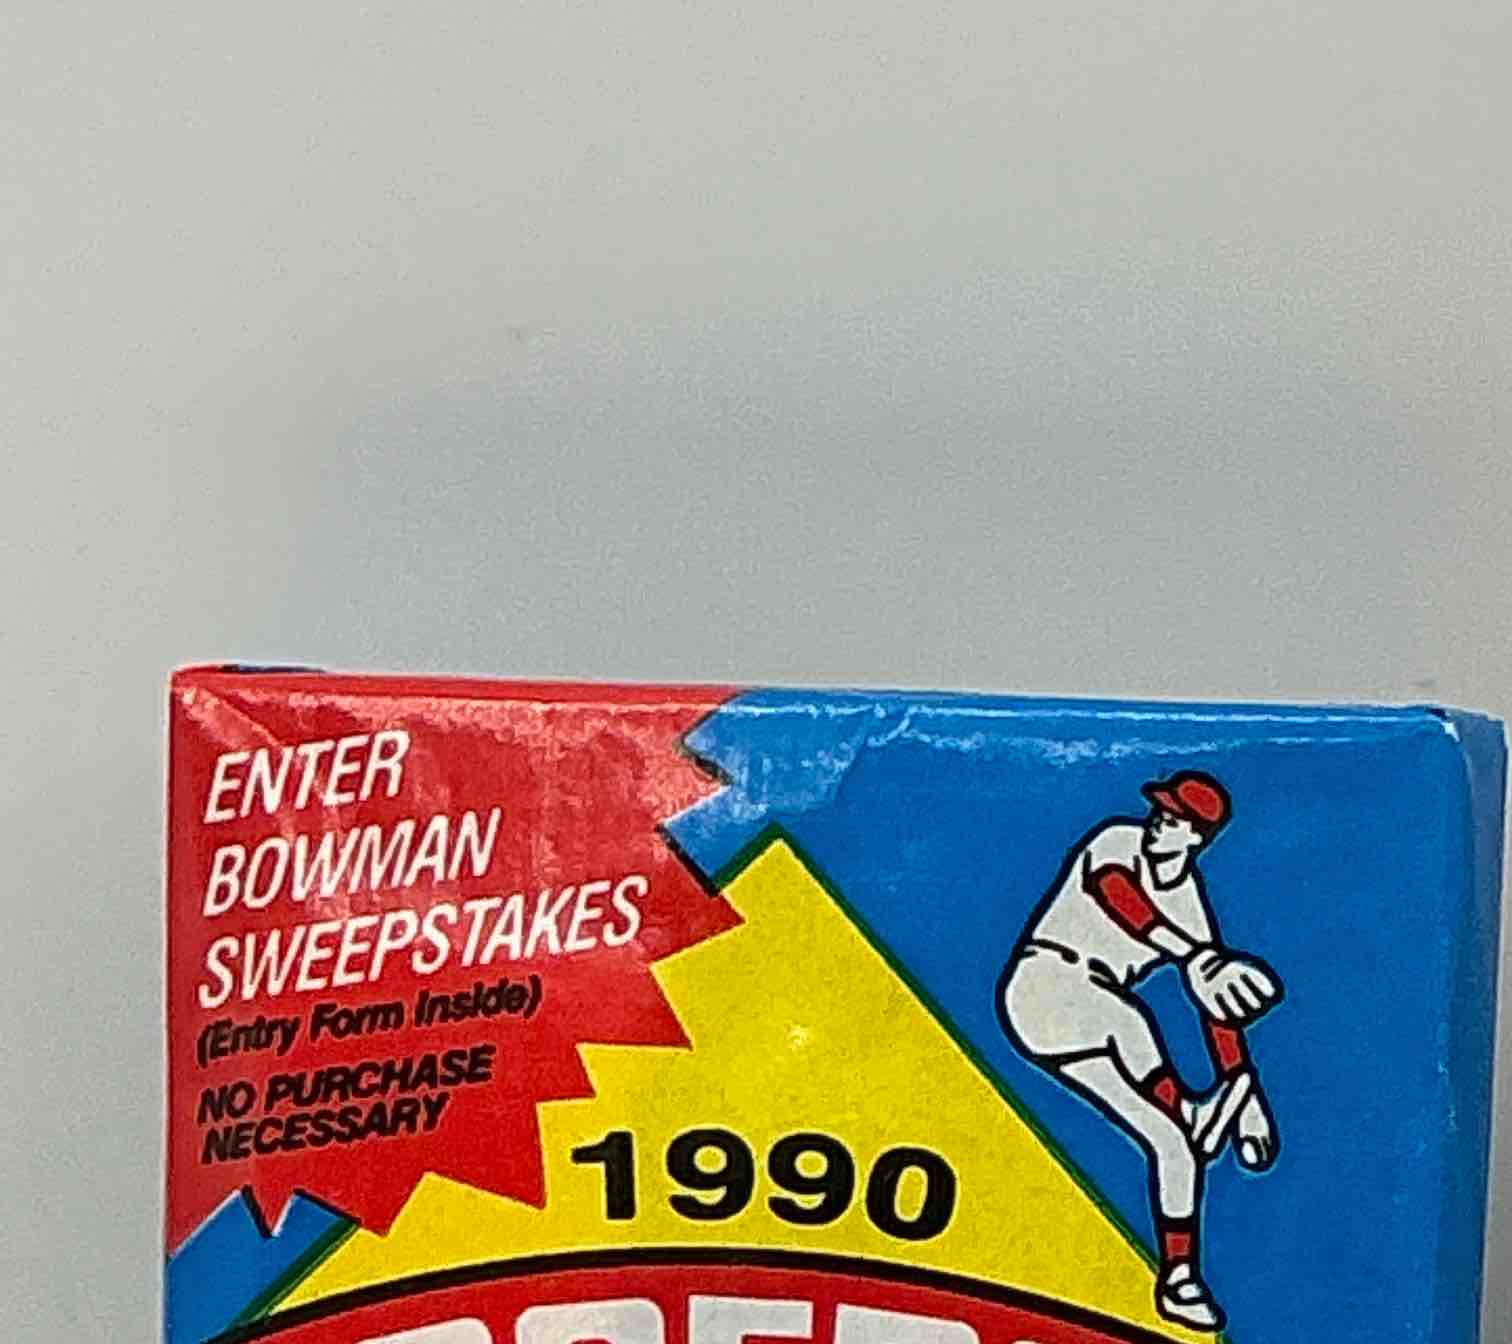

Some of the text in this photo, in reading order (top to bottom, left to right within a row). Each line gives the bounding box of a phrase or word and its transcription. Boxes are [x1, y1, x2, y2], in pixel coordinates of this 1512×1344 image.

[204, 730, 409, 823] ENTER
[204, 808, 500, 917] BOWMAN
[199, 876, 648, 1008] SWEEPSTAKES
[197, 976, 543, 1066] (Entry Form Inside)
[198, 1045, 496, 1124] NO PURCHASE
[202, 1094, 448, 1163] NECESSARY
[571, 1129, 956, 1240] 1990
